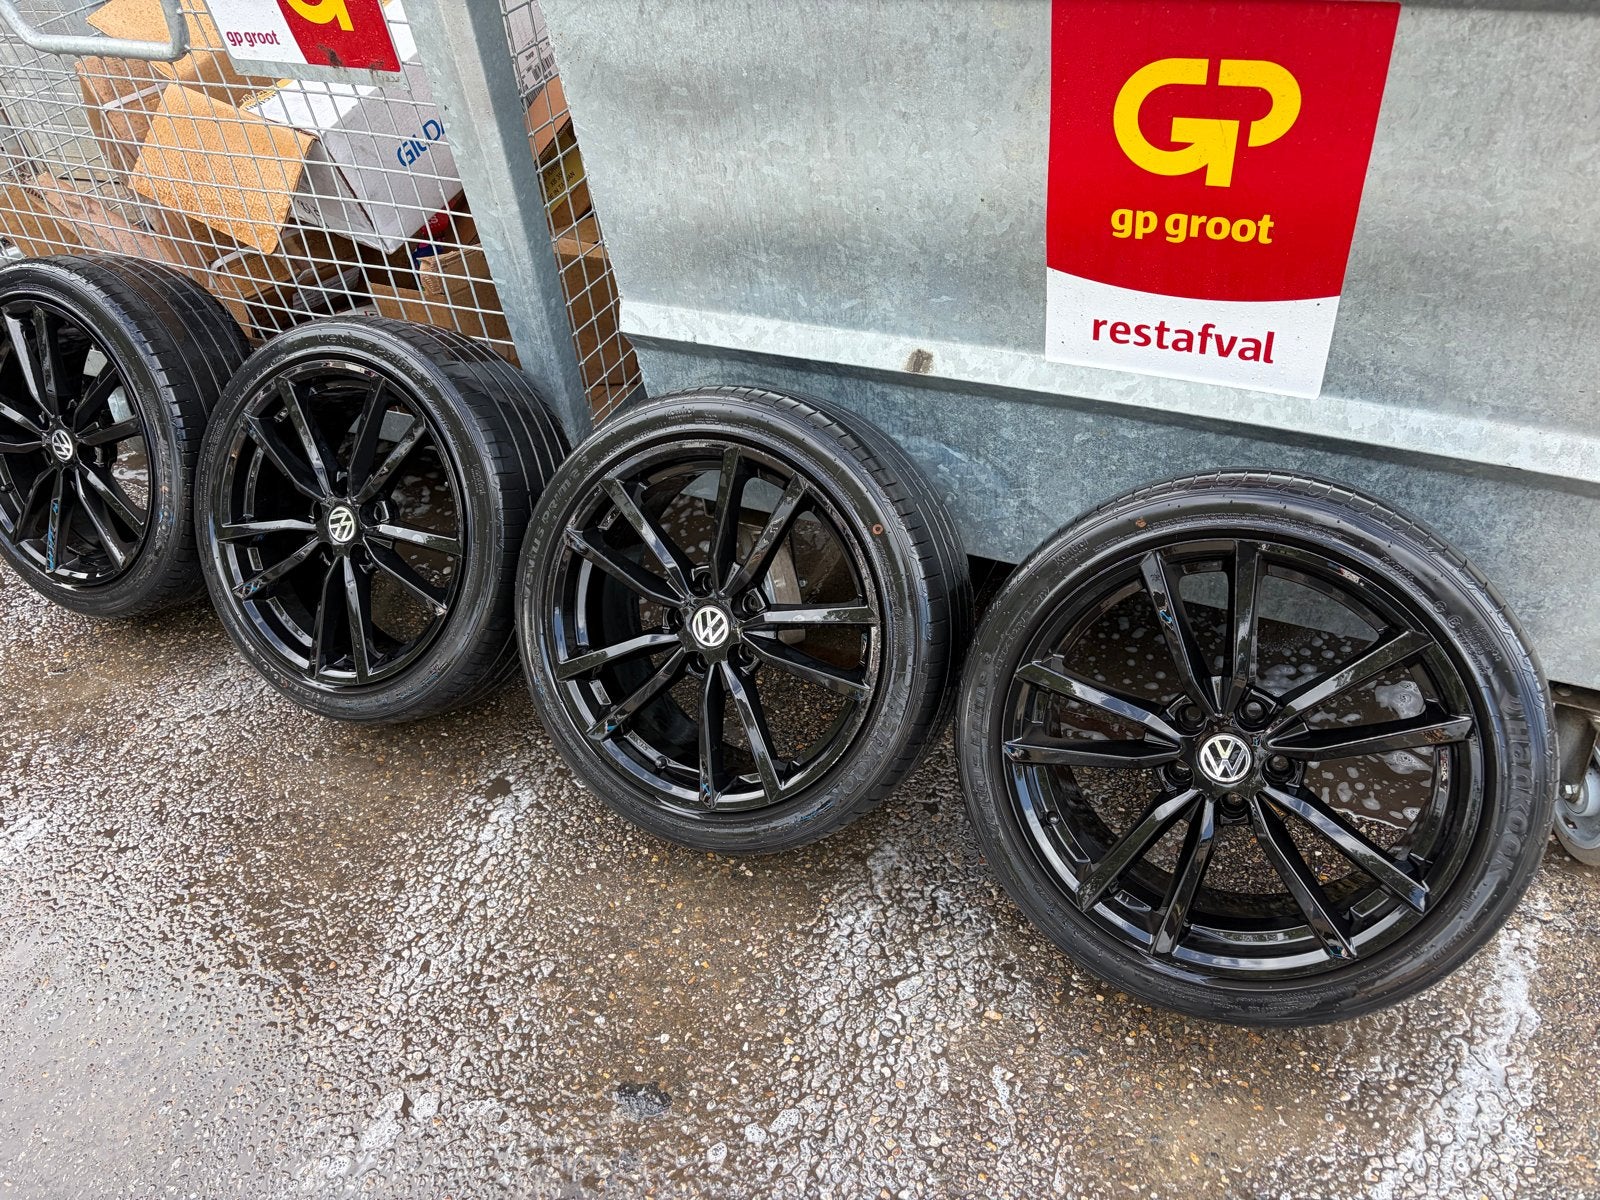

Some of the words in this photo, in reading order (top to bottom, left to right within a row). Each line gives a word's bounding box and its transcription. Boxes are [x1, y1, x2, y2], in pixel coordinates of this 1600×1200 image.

[226, 31, 243, 46] gp
[244, 32, 280, 46] groot
[397, 119, 444, 167] GILD
[1110, 208, 1158, 239] gp
[1164, 213, 1274, 244] groot
[1091, 318, 1275, 364] restafval
